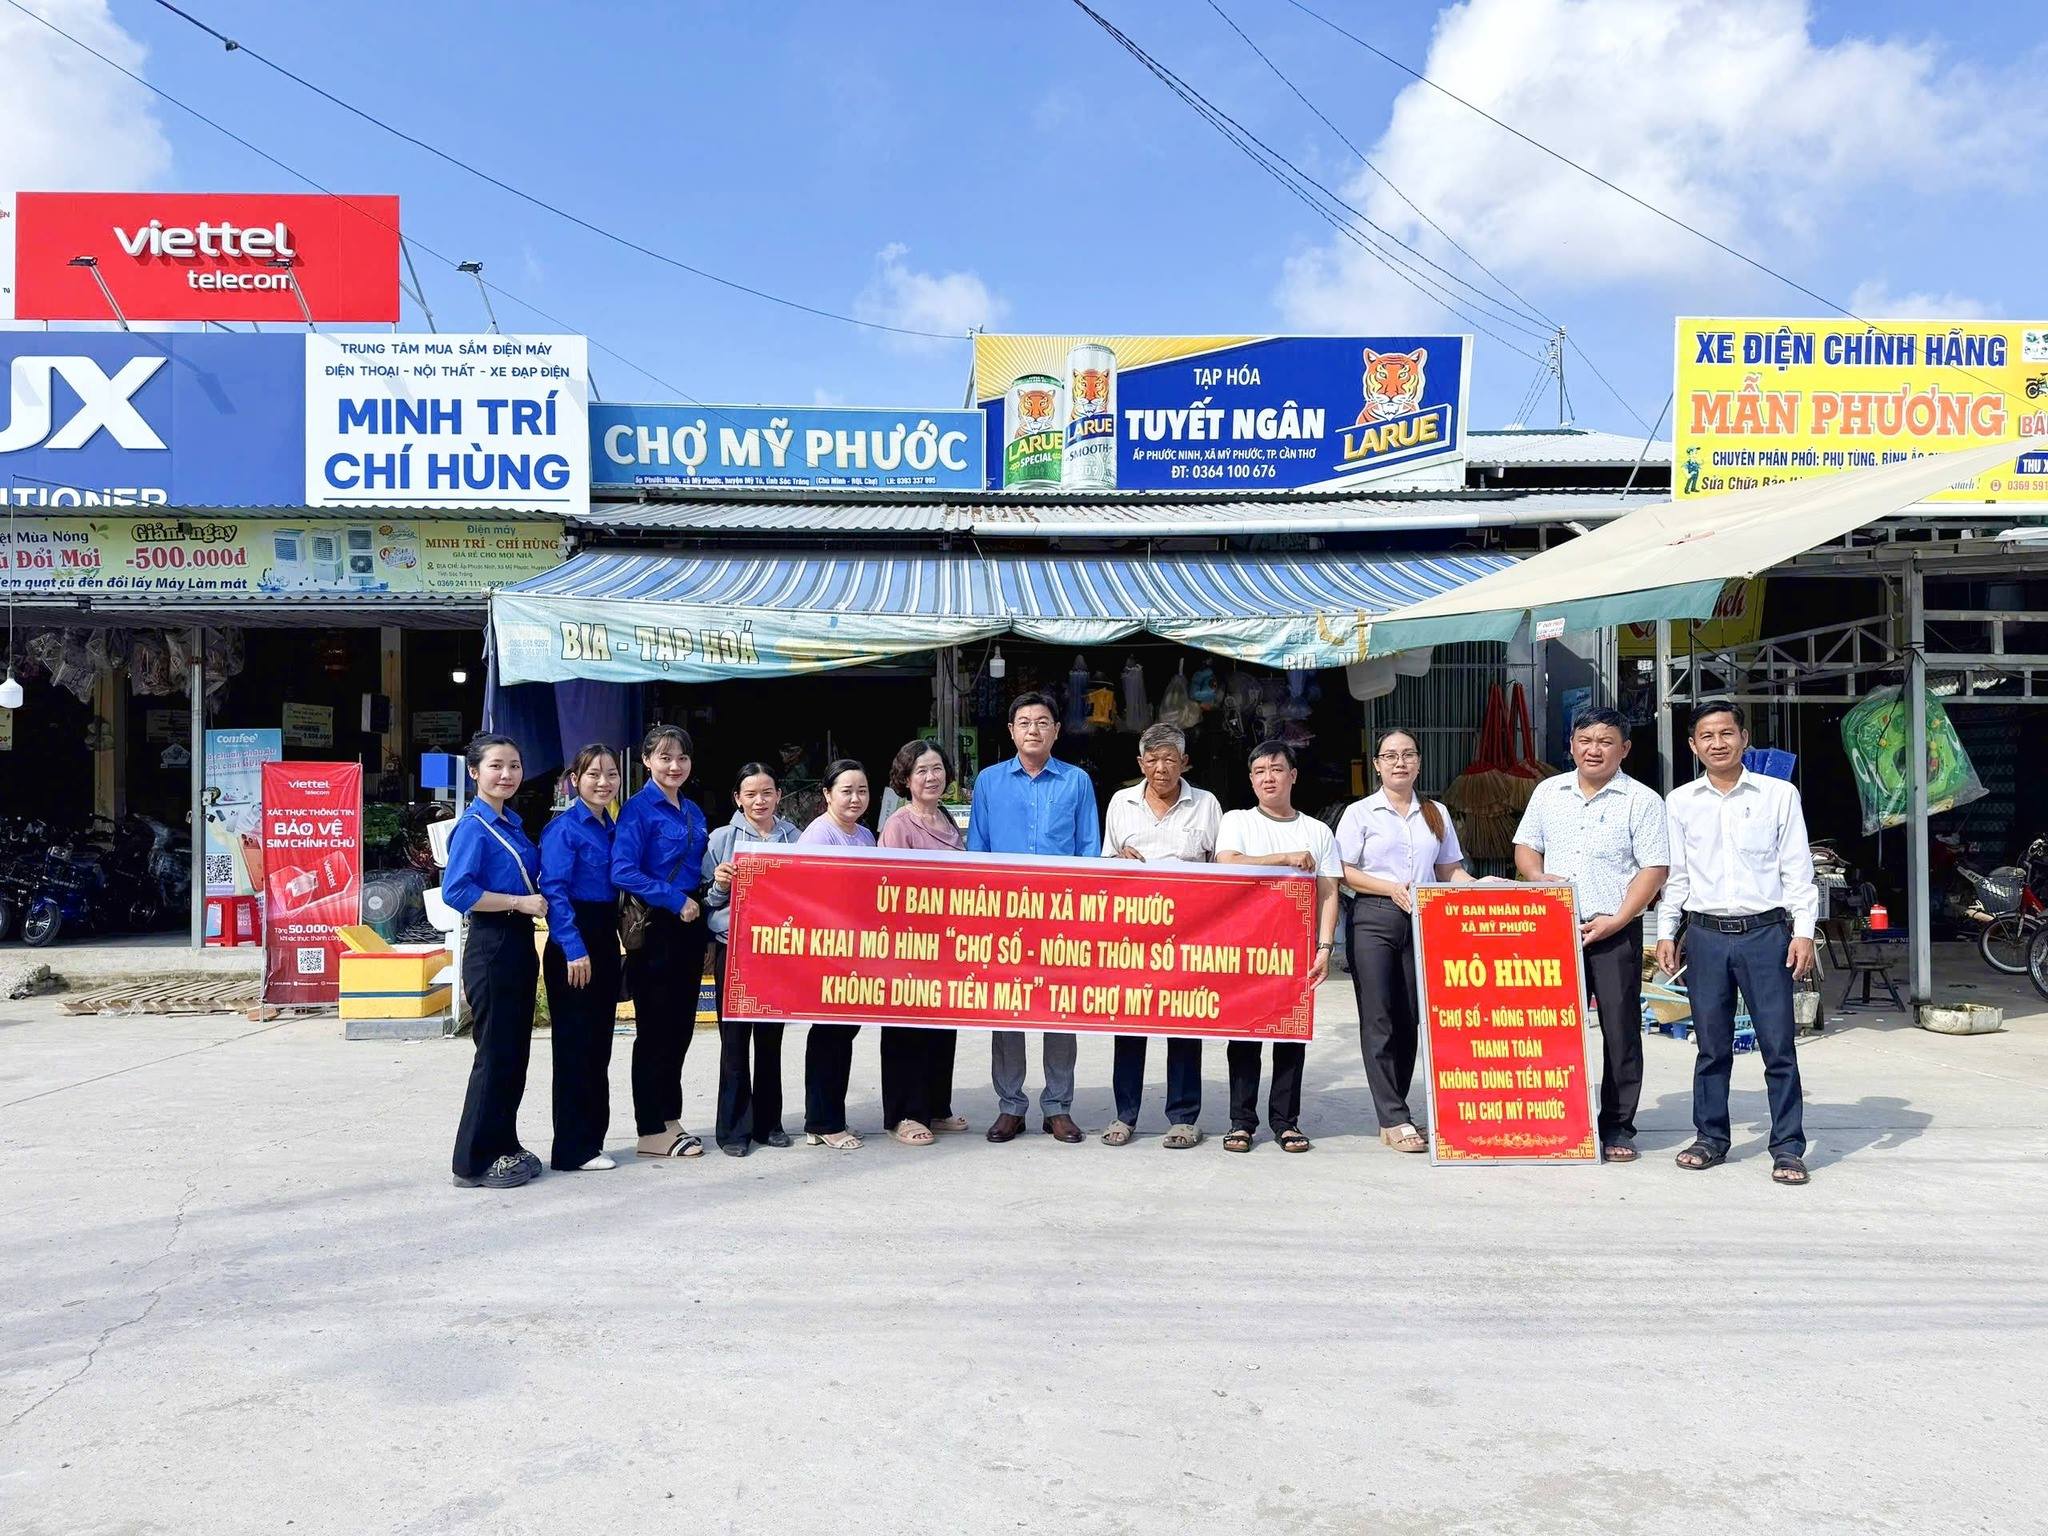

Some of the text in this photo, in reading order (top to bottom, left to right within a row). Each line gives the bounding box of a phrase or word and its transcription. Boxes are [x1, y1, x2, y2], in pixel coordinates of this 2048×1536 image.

[113, 219, 296, 257] viettel
[187, 269, 294, 289] telecom
[341, 341, 552, 357] TRUNG TÂM MUA SẮM ĐIỆN MÁY
[1695, 326, 2008, 371] XE ĐIỆN CHÍNH HÃNG
[325, 362, 570, 379] ĐIỆN THOẠI NỘI THẤT XE ĐẠP ĐIỆN
[1194, 364, 1261, 390] TẠP HÓA
[338, 389, 559, 436] MINH TRÍ
[1691, 372, 2007, 436] MẪN PHƯƠNG
[1068, 418, 1113, 439] LARUE
[1125, 397, 1325, 441] TUYẾT NGÂN
[603, 417, 969, 476] CHỢ MỸ PHƯỚC
[1344, 412, 1439, 460] LARUE
[1008, 433, 1063, 462] LARUE
[1133, 445, 1316, 461] ẤP PHƯỚC NINH, XÃ MỸ PHƯỚC, TP. CẦN THƠ
[1712, 449, 1755, 466] CHUYÊN
[1759, 449, 1787, 466] PHÂN
[1791, 446, 1819, 466] PHỐI:
[1823, 451, 1843, 470] PHỤ
[324, 442, 570, 490] CHÍ HÙNG
[1020, 453, 1053, 467] SPECIAL
[2023, 459, 2041, 473] THU
[1171, 465, 1276, 479] ĐT: 0364 100 676
[2008, 480, 2030, 491] 0369
[17, 531, 89, 543] Mùa Nóng
[131, 523, 238, 542] Giảm ngay
[494, 525, 516, 536] máy
[426, 535, 559, 550] MINH TRÍ CHÍ HÙNG
[16, 547, 102, 568] Đổi Mới
[126, 547, 248, 569] -500.000đ
[25, 574, 247, 590] quạt cũ đến đổi lấy Máy Làm mát
[560, 620, 759, 671] BIA TẠP HOÁ
[288, 780, 331, 788] viettel
[267, 808, 283, 816] XÁC
[285, 809, 307, 817] THỰC
[309, 808, 339, 816] THÔNG
[274, 818, 343, 838] BẢO VỆ
[267, 836, 355, 848] SIM CHÍNH CHỦ
[877, 876, 1175, 926] ỦY BAN NHÂN DÂN XÃ MỸ PHƯỚC
[1445, 902, 1547, 916] ỦY BAN NHÂN DÂN
[1461, 918, 1537, 933] XÃ MỸ PHƯỚC
[750, 916, 805, 955] TRIỂN
[810, 928, 854, 958] KHAI
[859, 925, 889, 959] MÔ
[895, 926, 939, 961] HÌNH
[998, 928, 1023, 965] SỐ
[1040, 933, 1091, 967] NÔNG
[1097, 936, 1144, 971] THÔN
[1150, 934, 1176, 972] SỐ
[1180, 944, 1240, 975] THANH
[1246, 943, 1294, 976] TOÁN
[1443, 953, 1562, 988] MÔ HÌNH
[821, 971, 885, 1006] KHÔNG
[890, 973, 942, 1008] DÙNG
[947, 972, 988, 1010] TIỀN
[1049, 985, 1076, 1019] TẠI
[1082, 984, 1121, 1021] CHỢ
[1124, 983, 1154, 1017] MỸ
[1158, 985, 1220, 1020] PHƯỚC
[1465, 1002, 1481, 1028] SỐ
[1492, 1006, 1524, 1028] NÔNG
[1527, 1006, 1558, 1028] THÔN
[1561, 1002, 1576, 1027] SỐ
[1470, 1037, 1543, 1059] THANH TOÁN
[1439, 1066, 1479, 1090] KHÔNG
[1481, 1067, 1513, 1089] DÙNG
[1517, 1065, 1542, 1089] TIỀN
[1458, 1100, 1566, 1126] TẠI CHỢ MỸ PHƯỚC
